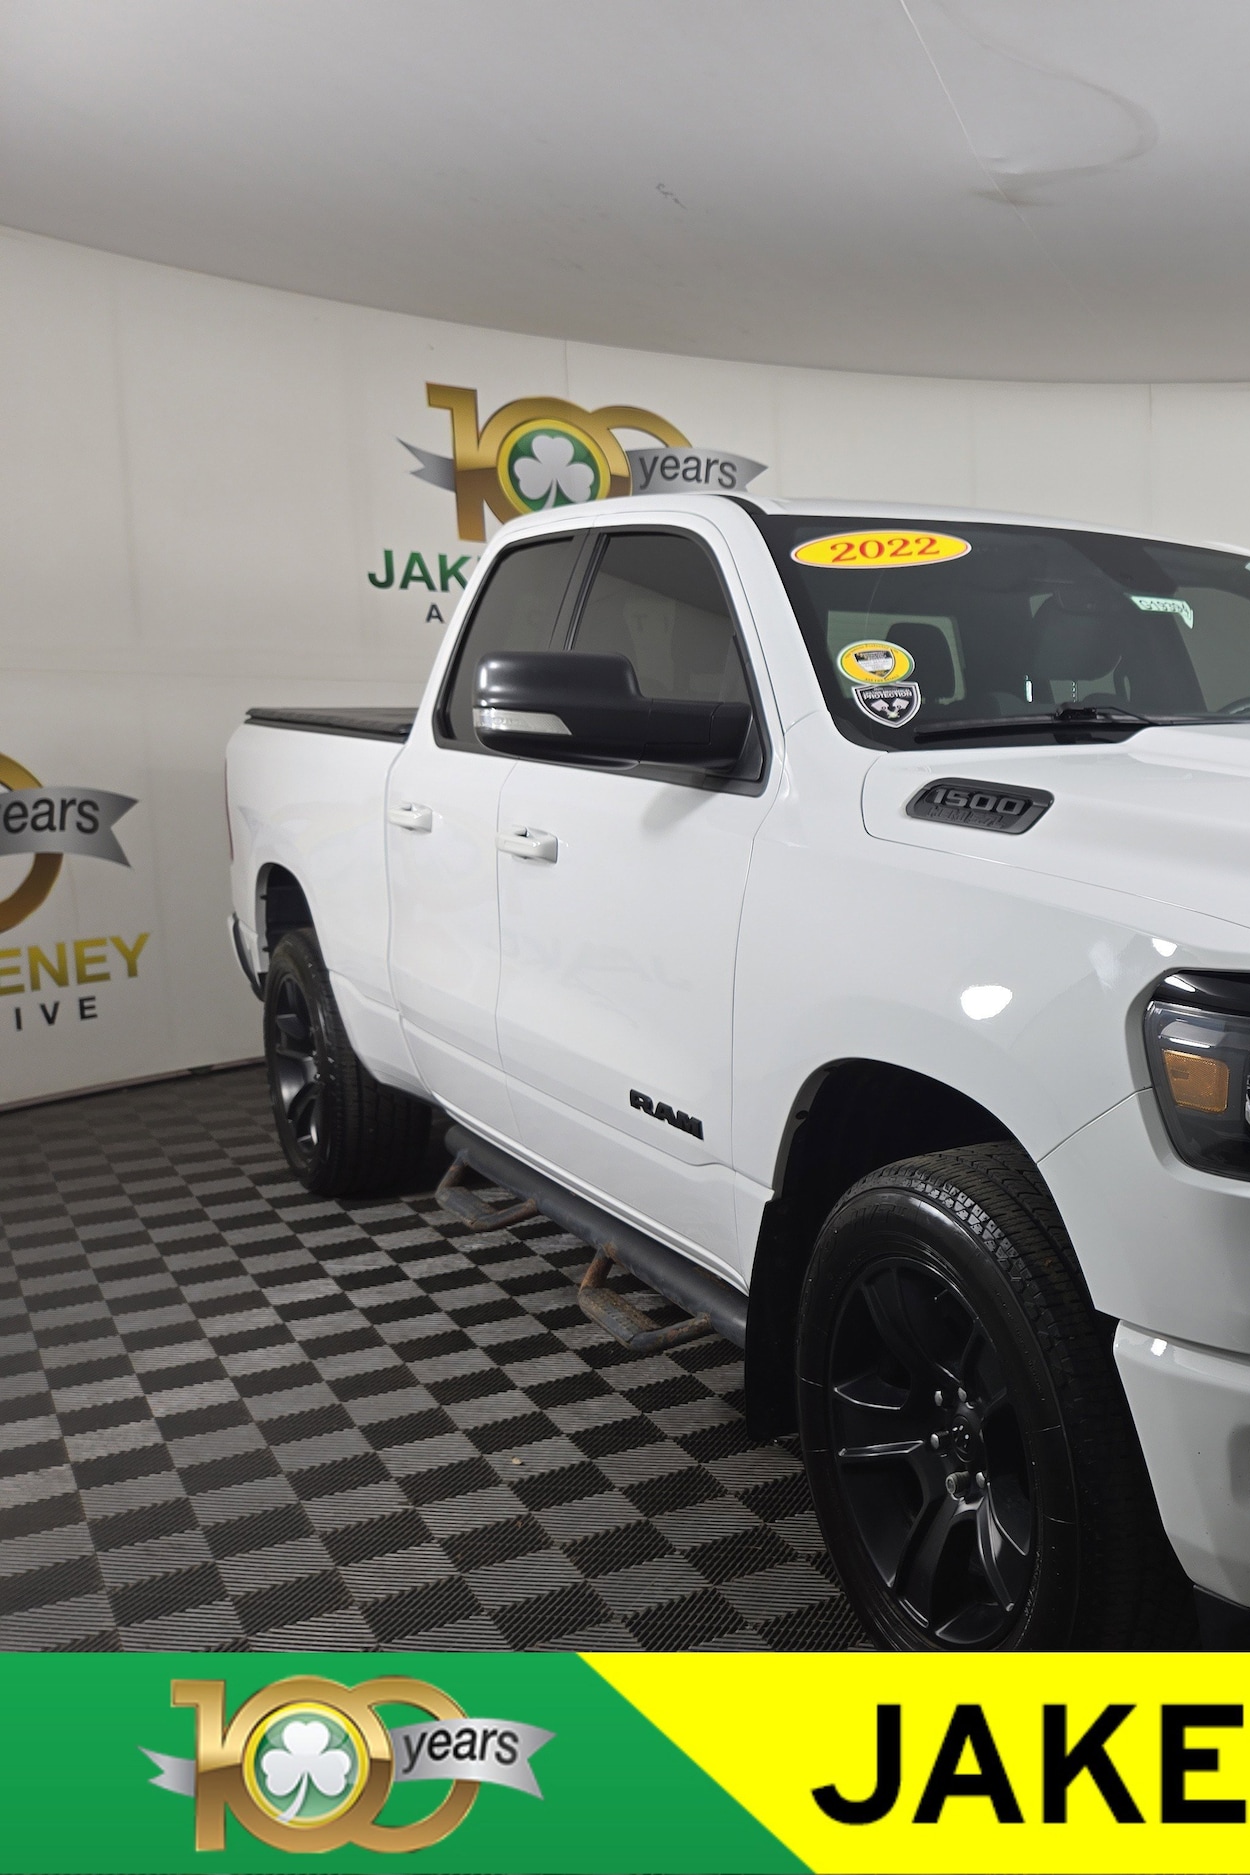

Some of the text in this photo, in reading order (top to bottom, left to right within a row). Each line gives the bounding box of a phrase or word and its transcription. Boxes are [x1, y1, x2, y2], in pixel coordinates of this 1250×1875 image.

[638, 453, 738, 490] years
[830, 537, 940, 563] 2022
[367, 548, 482, 593] JAK
[0, 797, 100, 834] ears
[934, 788, 1026, 815] 1500
[629, 1088, 705, 1142] RAM
